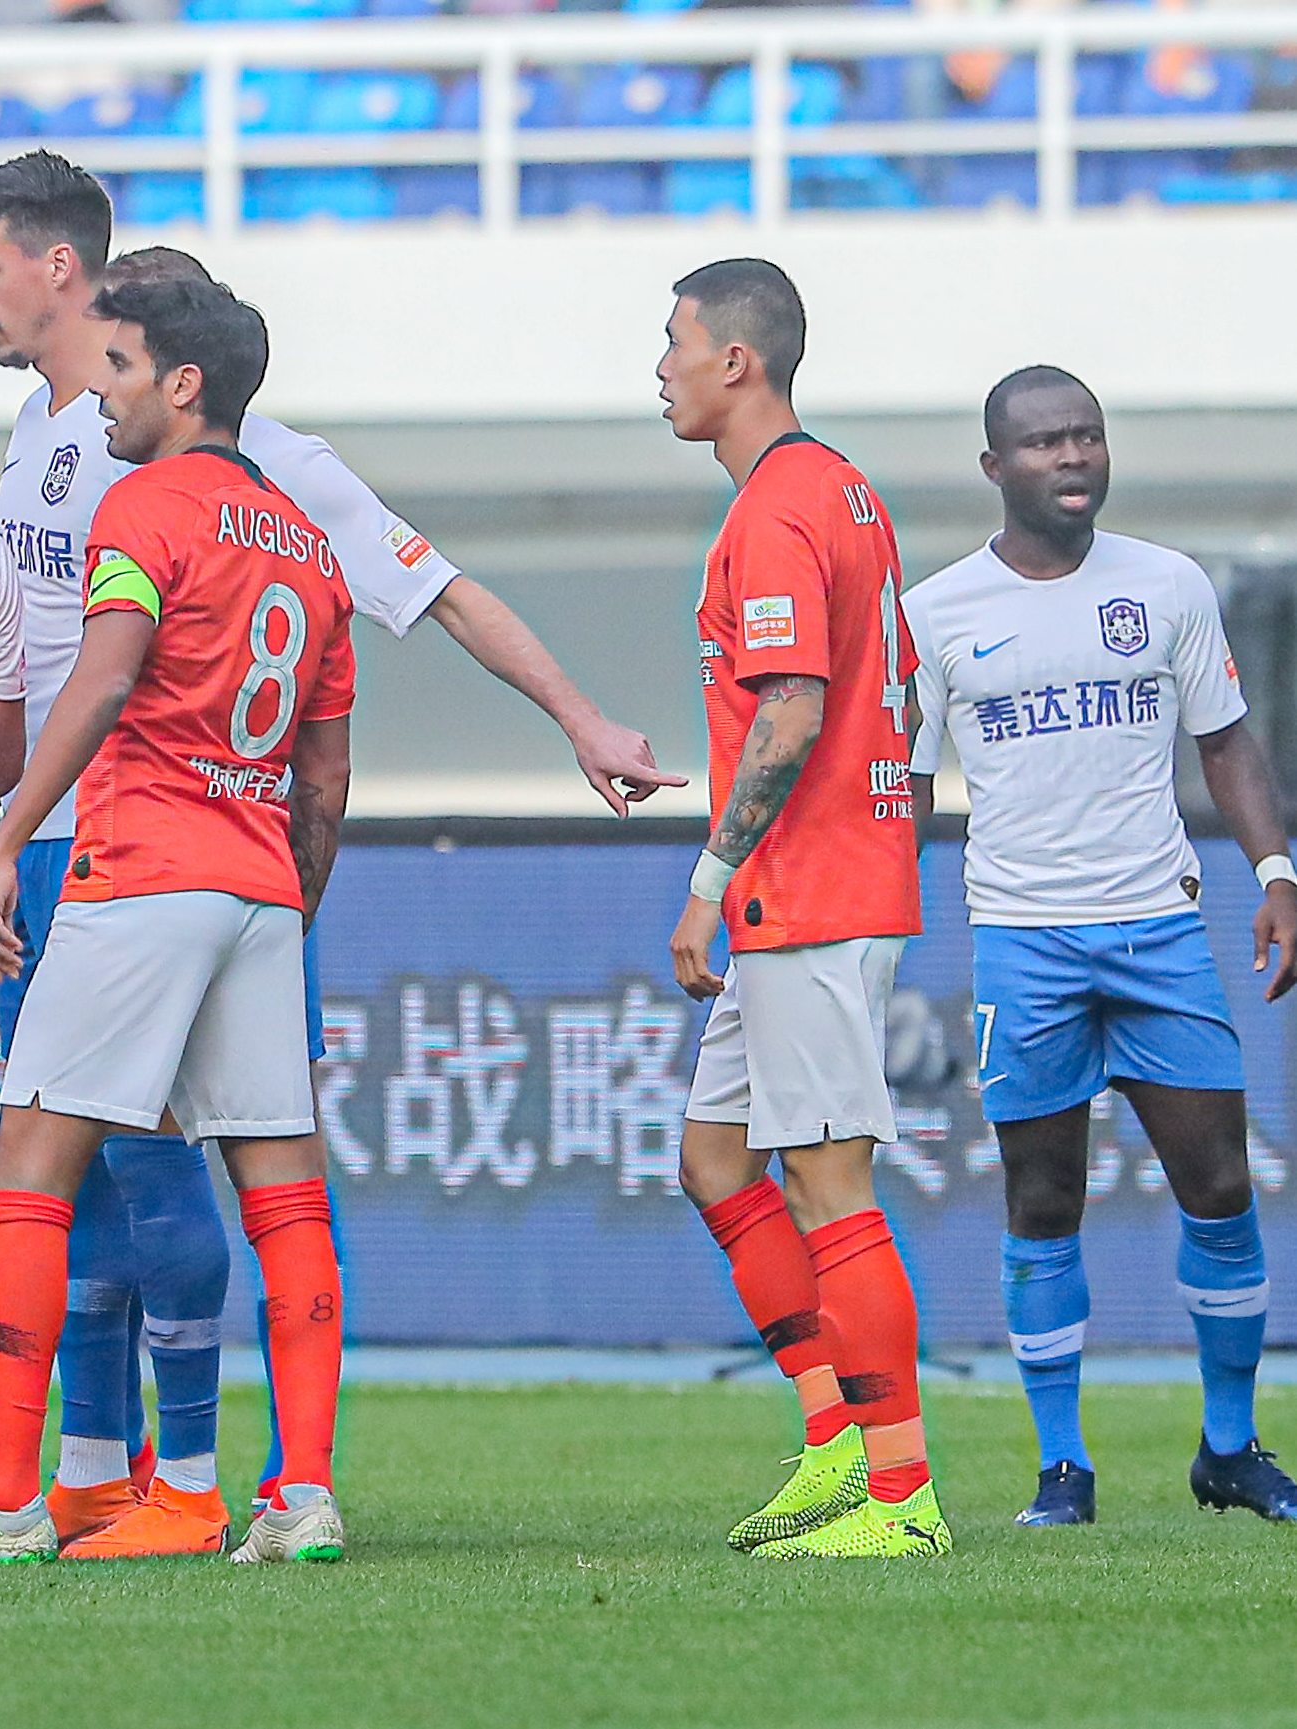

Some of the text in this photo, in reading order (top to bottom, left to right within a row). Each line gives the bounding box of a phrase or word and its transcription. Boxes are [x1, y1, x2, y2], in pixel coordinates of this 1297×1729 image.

[217, 503, 335, 578] AUGUSTO
[229, 582, 308, 760] 8
[974, 677, 1161, 744] 泰达环保
[976, 1003, 997, 1070] 7
[309, 1291, 334, 1323] 8
